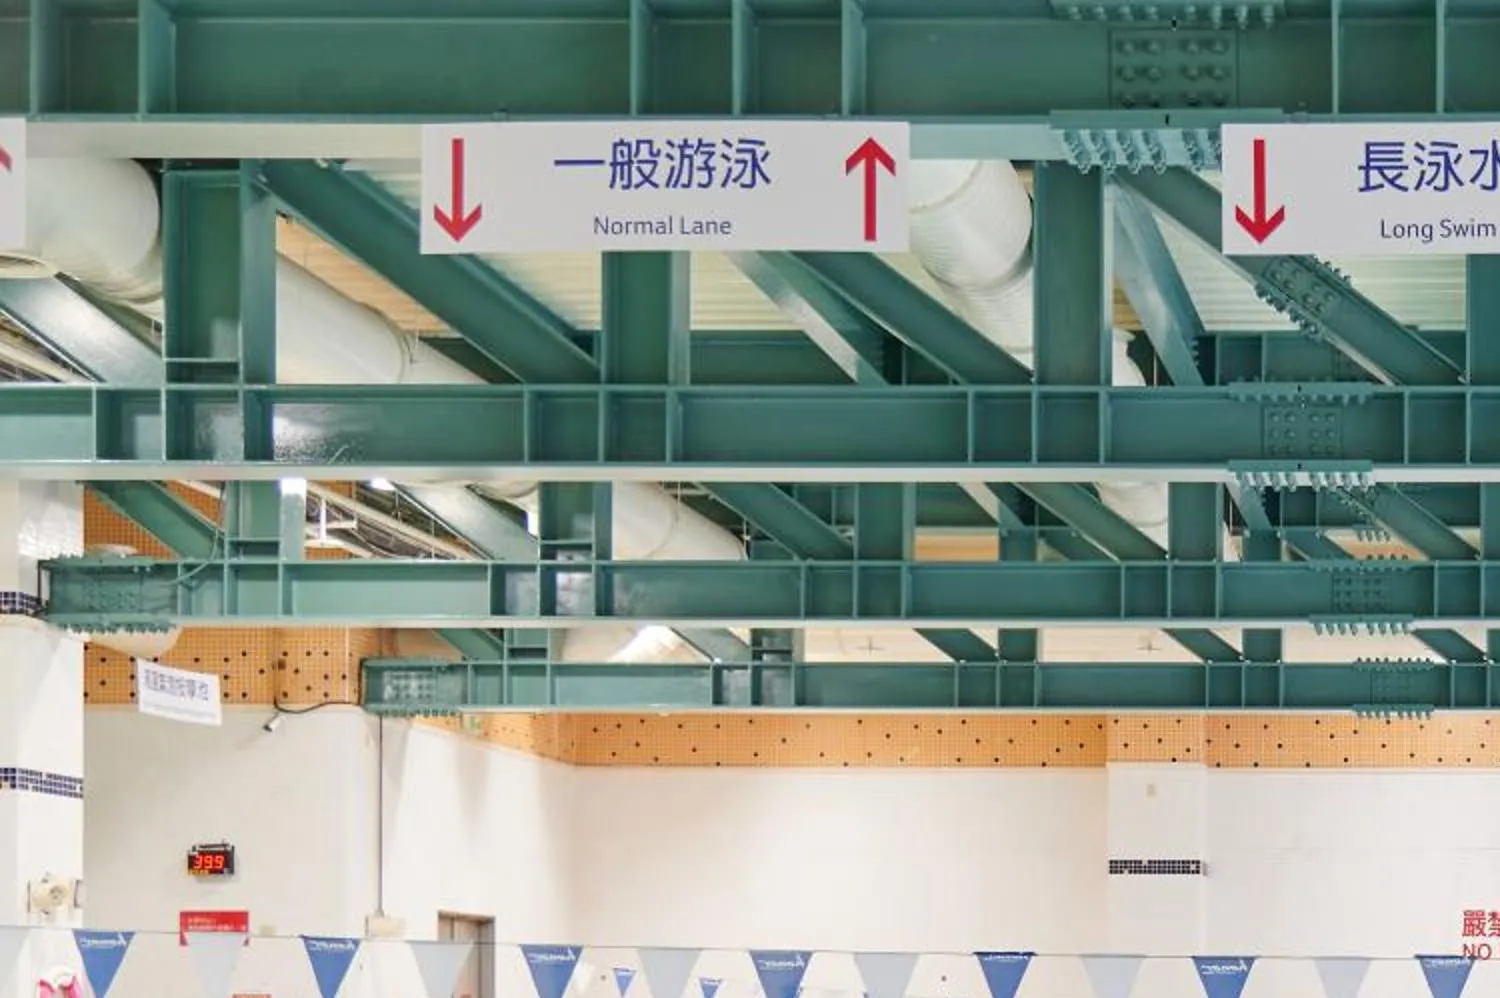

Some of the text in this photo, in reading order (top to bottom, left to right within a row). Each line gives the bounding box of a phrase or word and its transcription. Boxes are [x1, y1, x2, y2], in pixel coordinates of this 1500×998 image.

[553, 137, 772, 191] 一般游泳
[593, 215, 732, 236] Normal Lane
[1380, 218, 1434, 244] Long
[1439, 217, 1497, 238] Swim
[1462, 943, 1493, 960] NO
